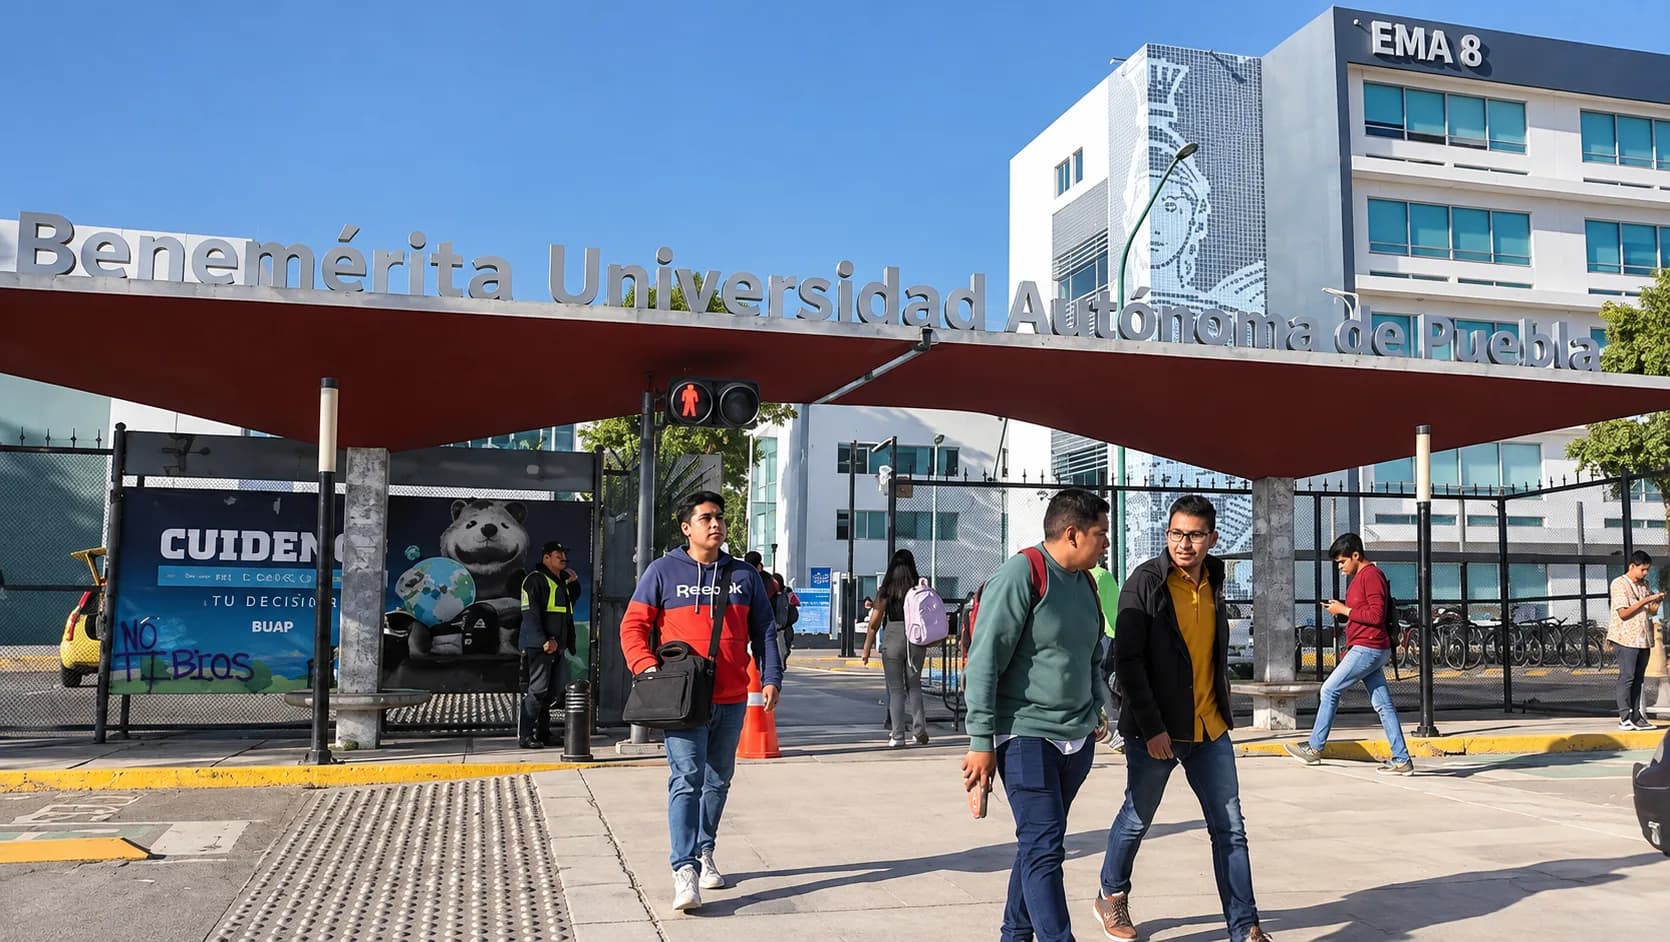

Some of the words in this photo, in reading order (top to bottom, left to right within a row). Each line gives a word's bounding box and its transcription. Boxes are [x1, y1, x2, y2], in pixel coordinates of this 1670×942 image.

[1371, 20, 1453, 64] EMA
[1460, 34, 1482, 67] 8
[16, 210, 513, 300] Benemérita
[548, 244, 985, 331] Universidad
[1004, 280, 1315, 353] Autónoma
[1335, 306, 1406, 358] de
[1418, 314, 1601, 372] Puebla
[252, 621, 293, 633] BUAP
